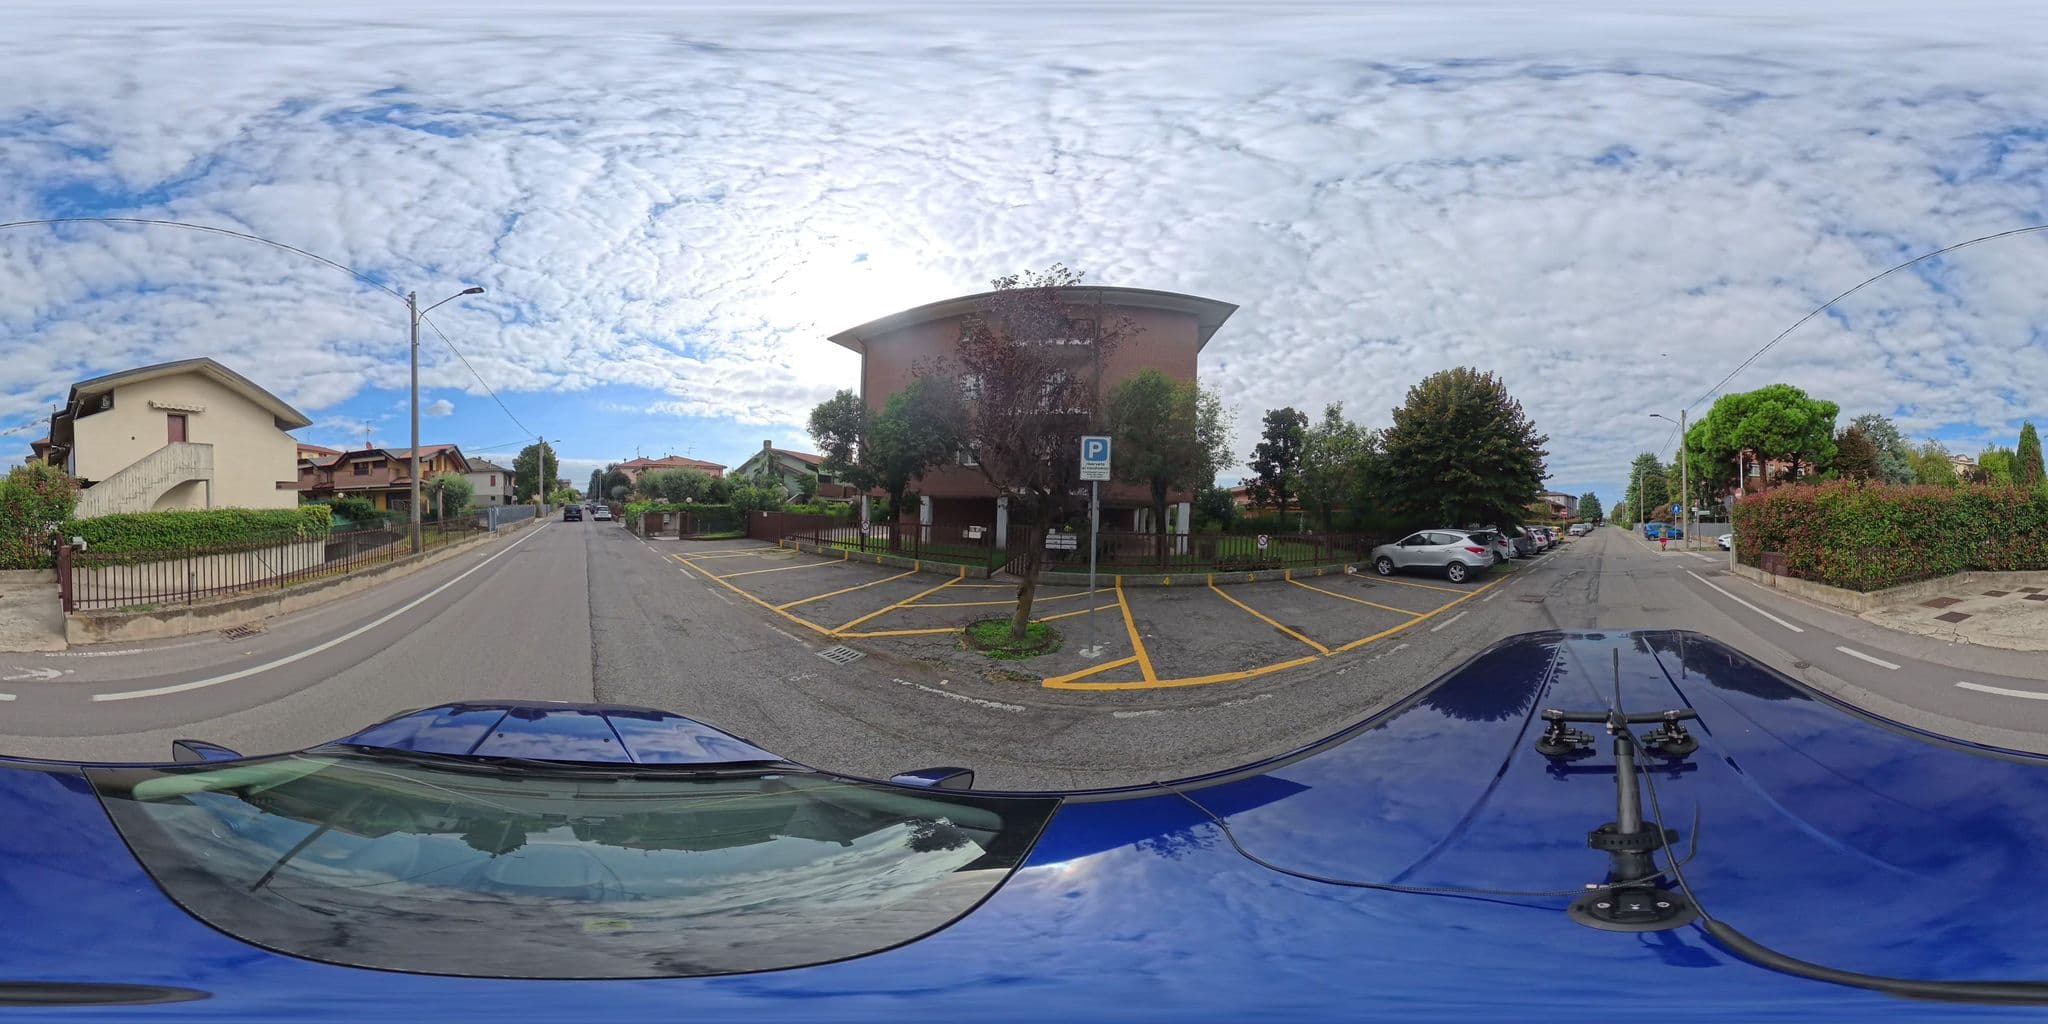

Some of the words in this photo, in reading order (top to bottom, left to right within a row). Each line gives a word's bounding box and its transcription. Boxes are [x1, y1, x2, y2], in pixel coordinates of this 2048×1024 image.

[1088, 441, 1103, 459] P
[1163, 576, 1171, 586] 4
[1248, 573, 1256, 582] 3
